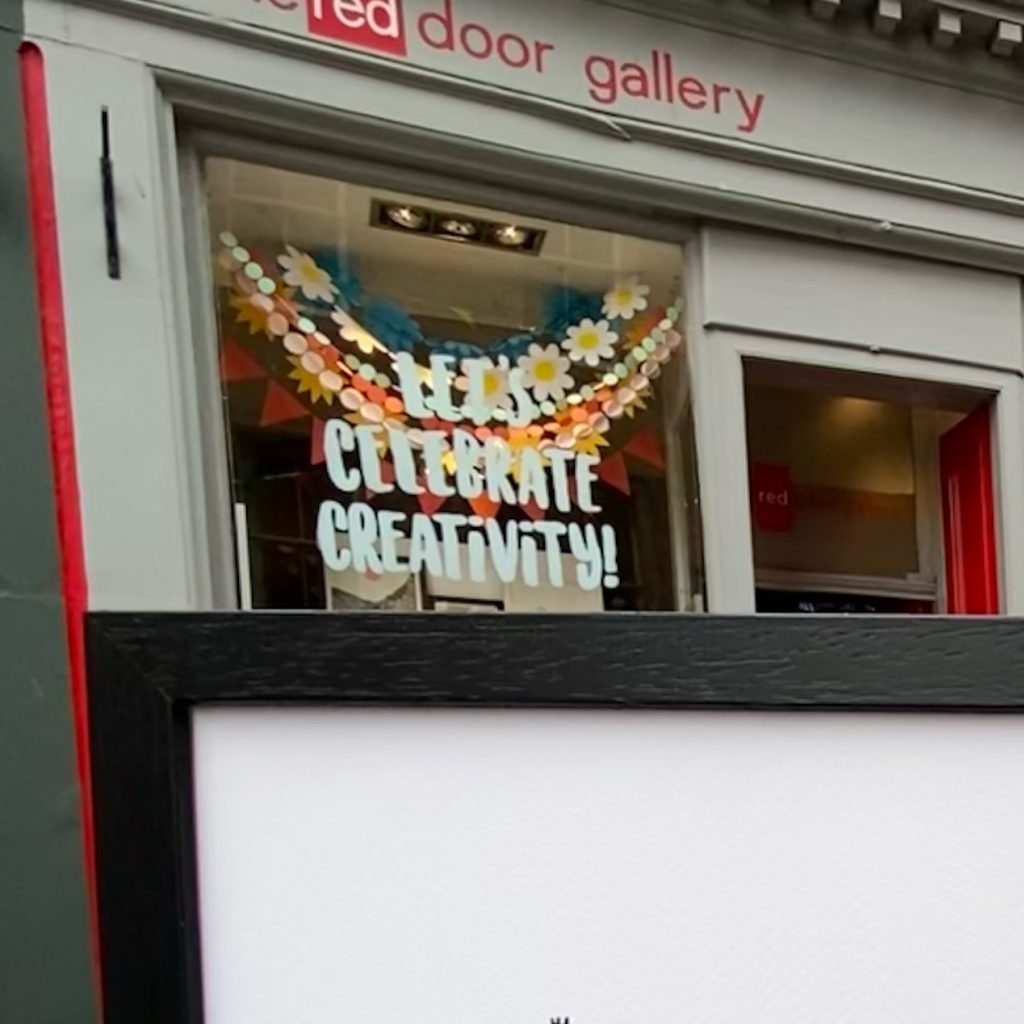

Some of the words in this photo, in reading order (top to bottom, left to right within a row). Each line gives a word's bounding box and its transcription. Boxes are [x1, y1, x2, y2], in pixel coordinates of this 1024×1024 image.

[418, 0, 554, 72] door
[585, 49, 764, 132] gallery
[322, 418, 603, 513] CELEBRATE
[758, 489, 789, 506] red
